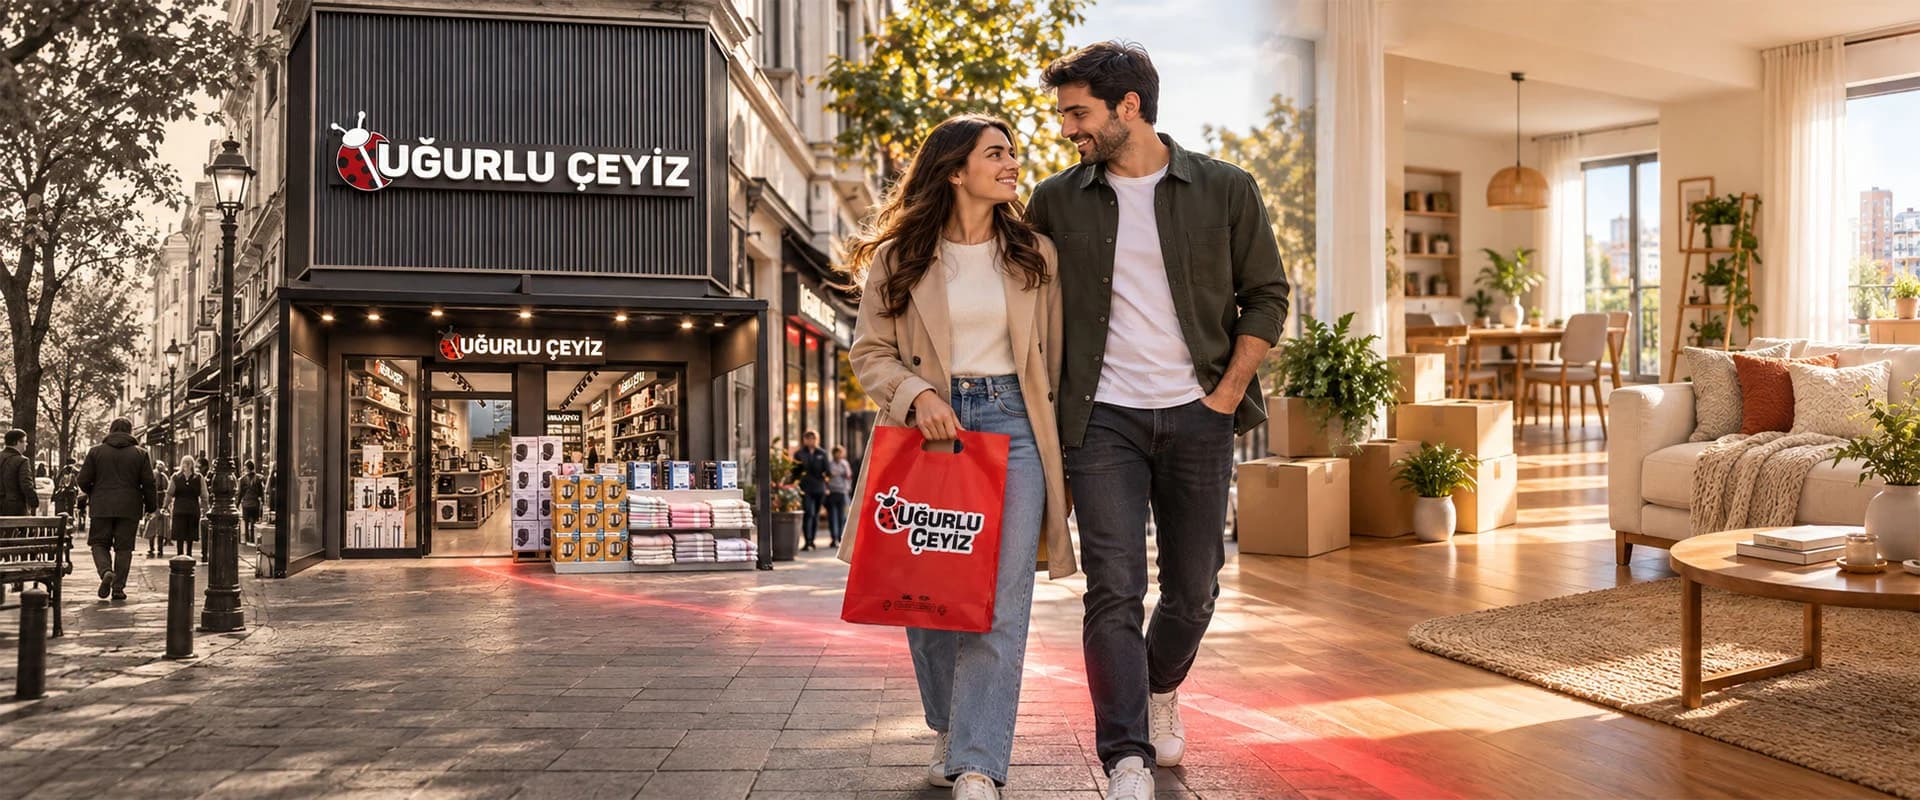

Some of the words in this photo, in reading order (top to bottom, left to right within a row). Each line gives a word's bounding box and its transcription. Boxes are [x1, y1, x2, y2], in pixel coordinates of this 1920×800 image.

[378, 136, 555, 184] UĞURLU
[567, 147, 690, 192] ÇEYİZ
[460, 333, 542, 355] UĞURLU
[546, 336, 603, 361] ÇEYİZ
[898, 505, 982, 532] UĞURLU
[910, 528, 973, 552] ÇEYİZ
